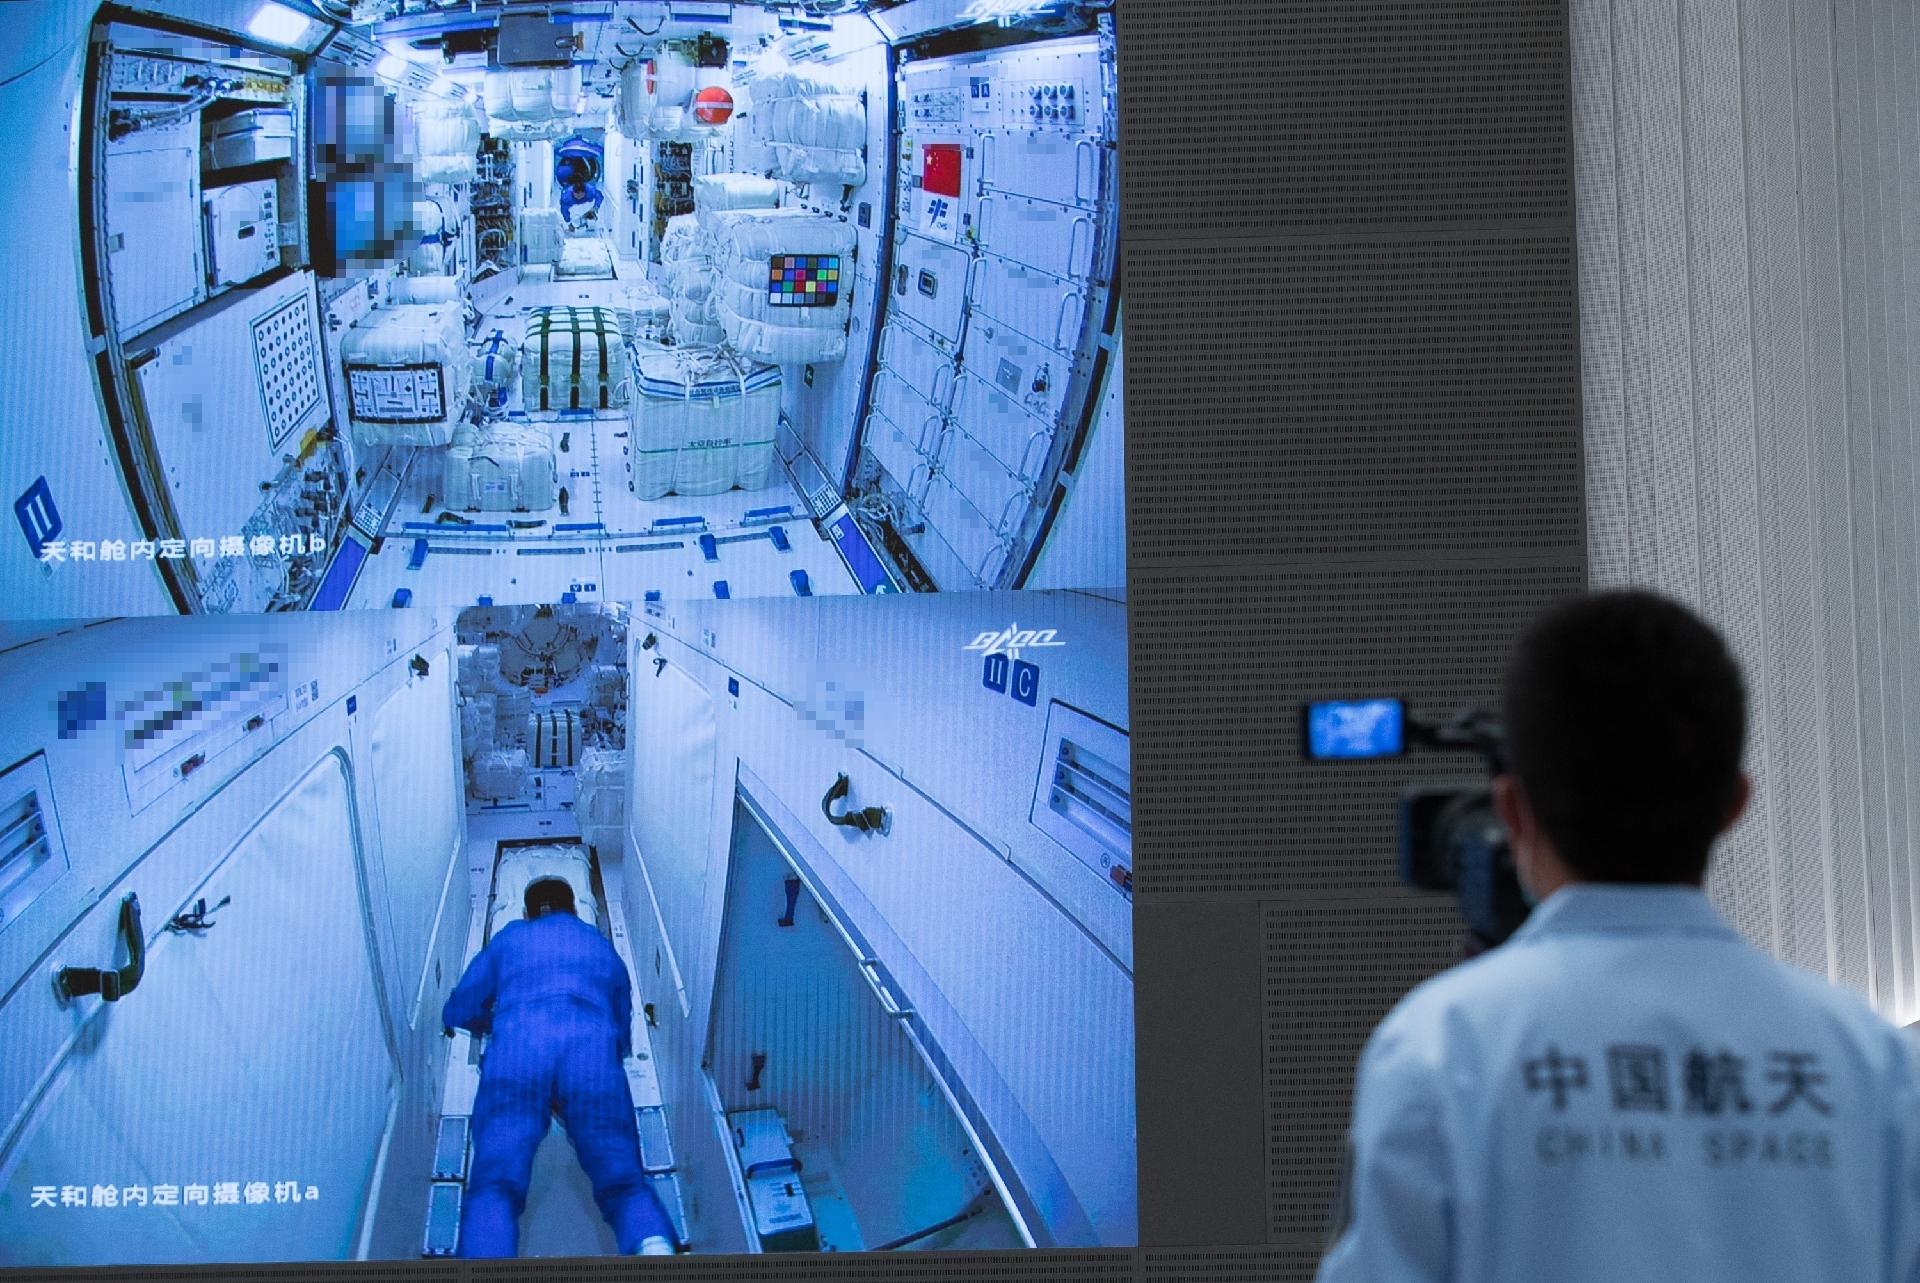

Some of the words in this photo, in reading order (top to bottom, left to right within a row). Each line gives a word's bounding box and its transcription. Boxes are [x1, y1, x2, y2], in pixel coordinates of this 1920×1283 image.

[39, 532, 327, 562] 天和舱内定向摄像机b
[1018, 667, 1032, 697] C
[1520, 1042, 1836, 1117] 中国航天
[1535, 1126, 1666, 1167] CHINA
[1703, 1130, 1836, 1169] SPACE
[30, 1180, 320, 1208] 天和舱内定向摄像机a
